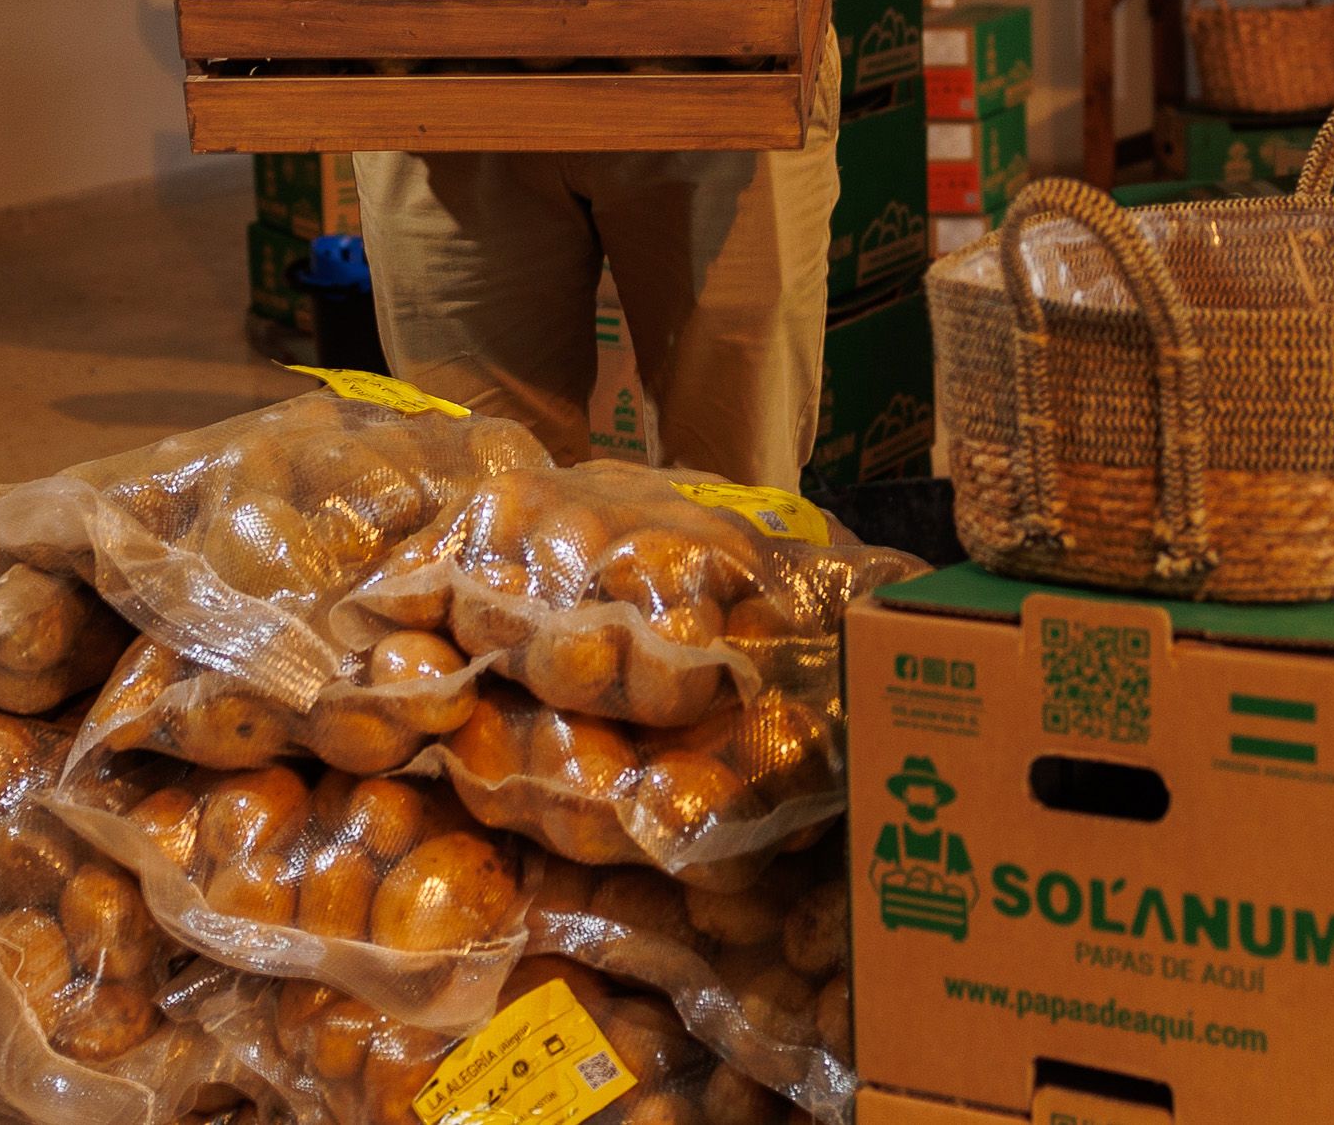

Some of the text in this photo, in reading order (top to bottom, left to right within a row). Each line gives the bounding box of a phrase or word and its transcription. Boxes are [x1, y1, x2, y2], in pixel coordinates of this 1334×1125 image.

[1075, 941, 1153, 975] PAPAS
[1161, 955, 1194, 982] DE
[944, 976, 1269, 1052] www.papasdeaqui.com
[426, 1093, 446, 1111] LA
[446, 1050, 498, 1095] ALEGRÍA
